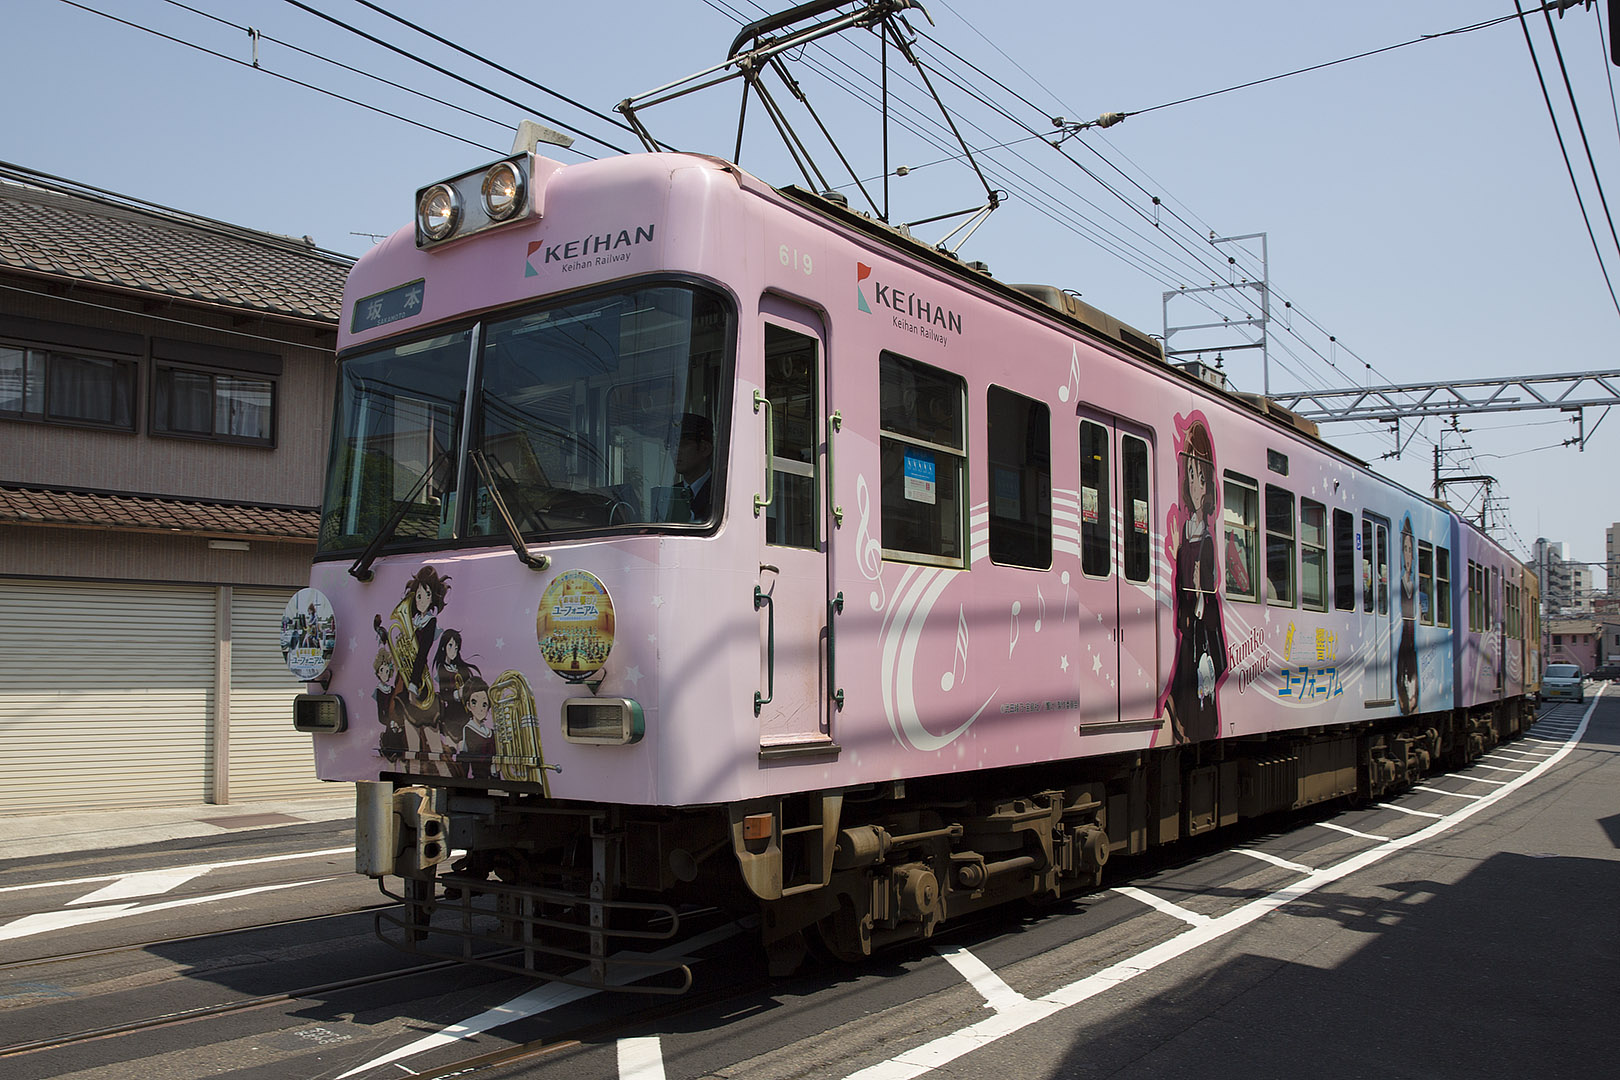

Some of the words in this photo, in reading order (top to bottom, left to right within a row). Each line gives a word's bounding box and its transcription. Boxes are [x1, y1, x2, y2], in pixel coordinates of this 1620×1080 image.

[561, 259, 592, 273] Keihan
[595, 252, 631, 267] Railway
[779, 244, 812, 275] 619
[376, 311, 406, 326] SAKAMOTO
[892, 315, 918, 335] Keihan
[920, 325, 948, 348] Railway
[1227, 626, 1265, 673] Kumiko
[1238, 650, 1271, 694] Oumae
[1278, 666, 1343, 700] ユーフォニアム
